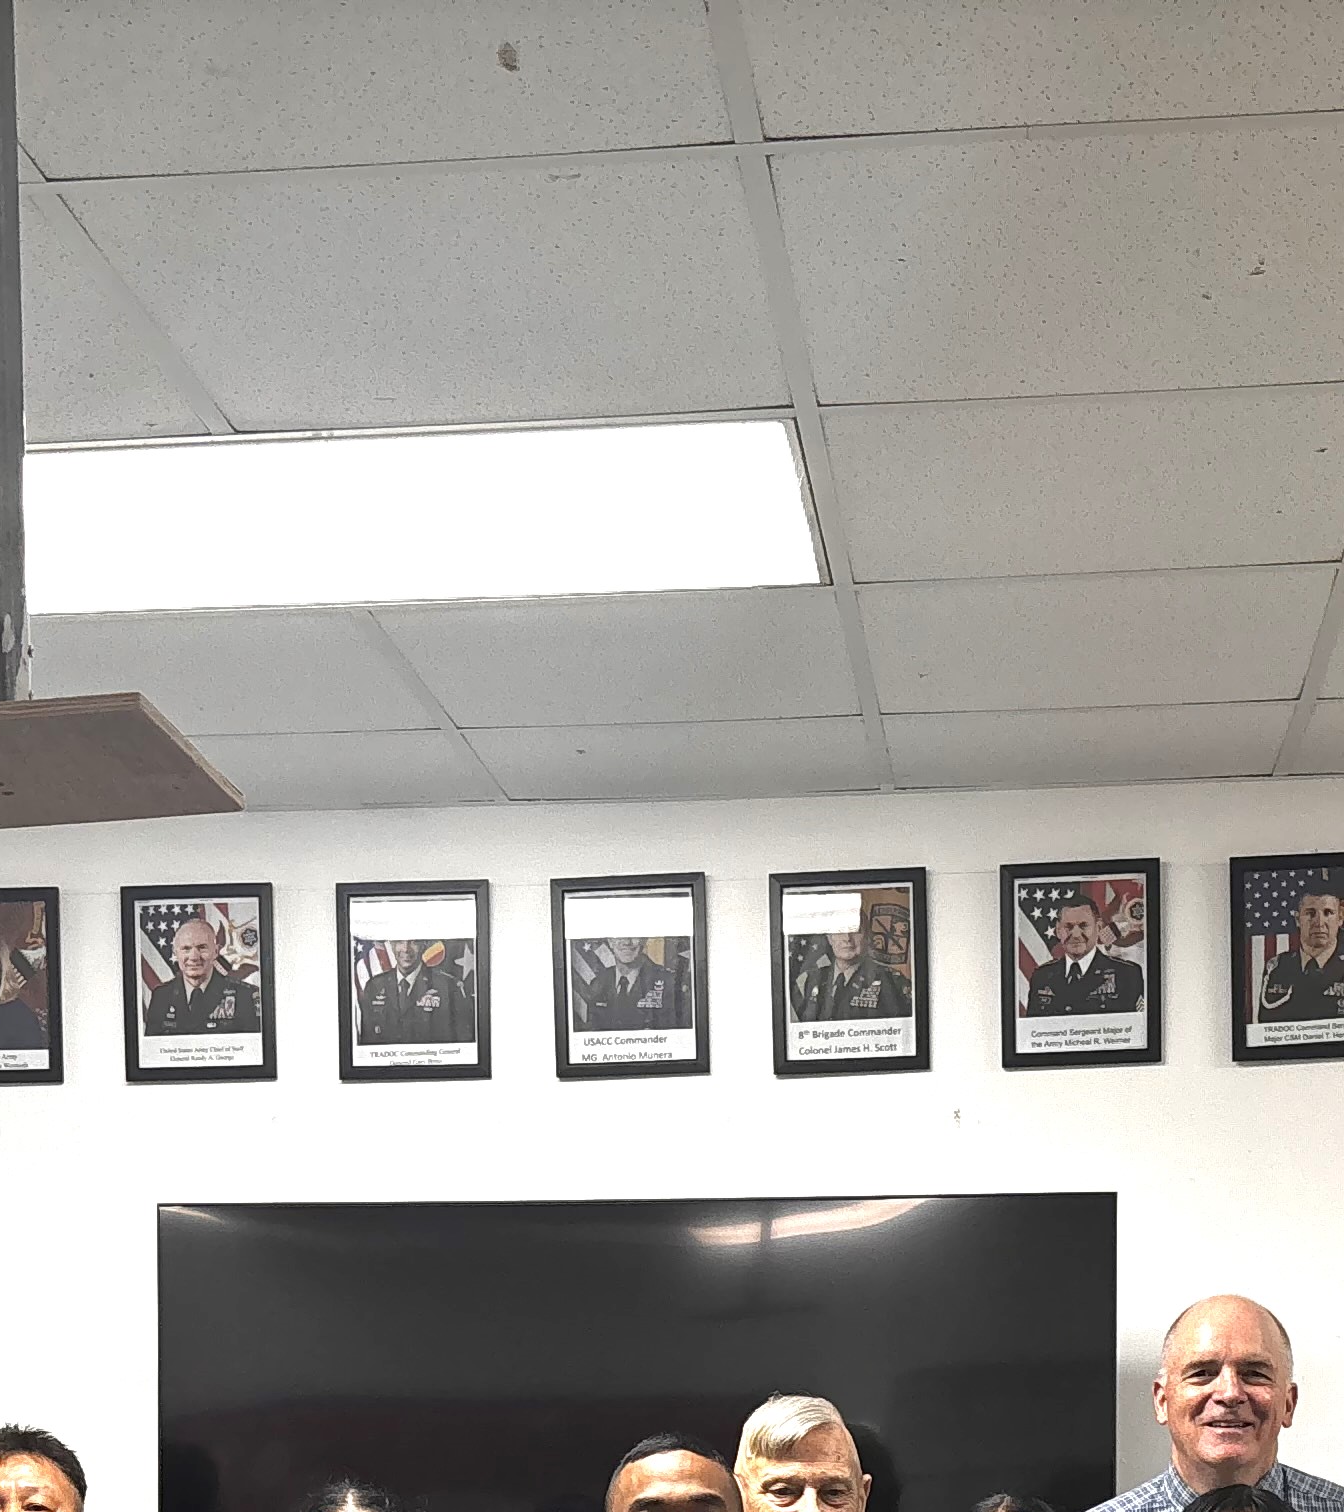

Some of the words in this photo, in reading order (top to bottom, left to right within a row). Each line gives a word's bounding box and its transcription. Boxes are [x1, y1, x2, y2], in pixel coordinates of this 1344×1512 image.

[812, 1029, 845, 1040] Brigade
[847, 1026, 902, 1037] Commander
[1103, 1026, 1123, 1035] Major
[583, 1037, 613, 1046] USACC
[614, 1035, 668, 1045] Commander
[1043, 1040, 1063, 1048] Army
[798, 1045, 832, 1055] Colonel
[834, 1045, 861, 1054] James
[875, 1043, 897, 1052] Scott
[581, 1054, 597, 1062] MG
[602, 1052, 636, 1061] Antonio
[639, 1051, 672, 1060] Munera
